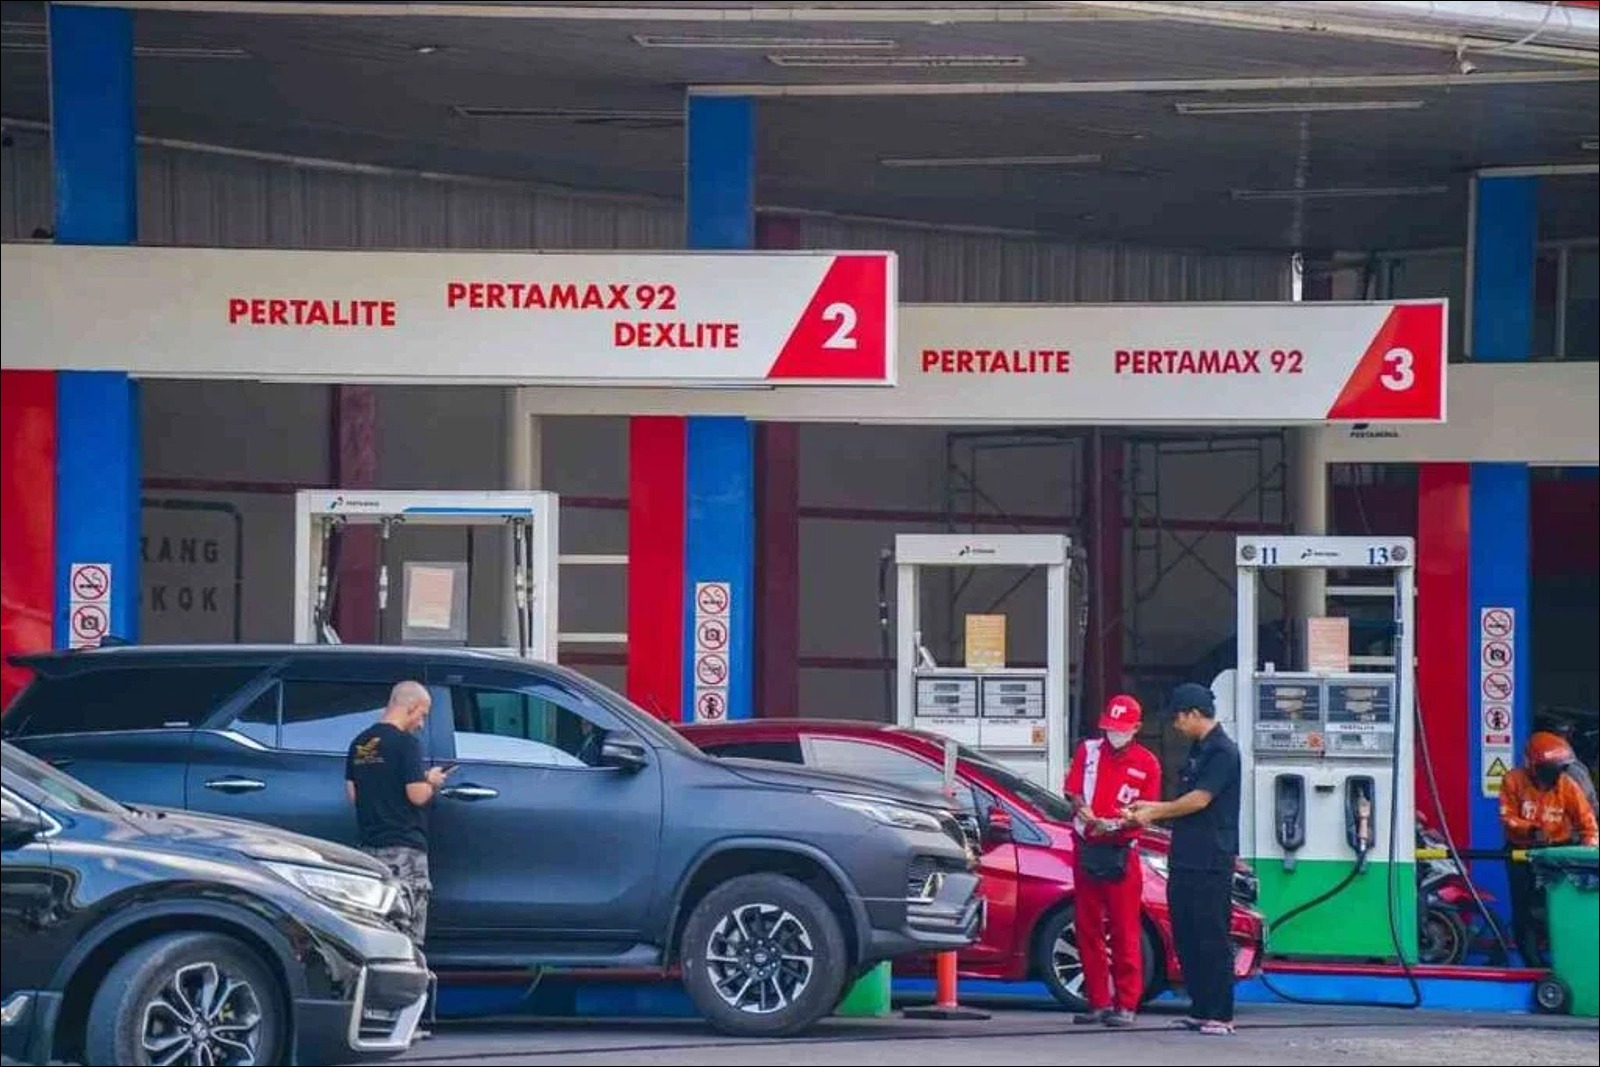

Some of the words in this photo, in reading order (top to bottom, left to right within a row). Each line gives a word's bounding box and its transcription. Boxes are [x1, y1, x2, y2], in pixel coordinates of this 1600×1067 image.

[447, 282, 630, 310] PERTAMAX
[636, 284, 677, 311] 92
[228, 298, 396, 328] PERTALITE
[821, 303, 857, 350] 2
[614, 321, 739, 350] DEXLITE
[921, 349, 1071, 376] PERTALITE
[1114, 350, 1261, 376] PERTAMAX
[1269, 349, 1304, 375] 92
[1382, 347, 1416, 391] 3
[1261, 547, 1278, 565] 11
[1368, 547, 1389, 565] 13
[138, 586, 217, 612] KOK
